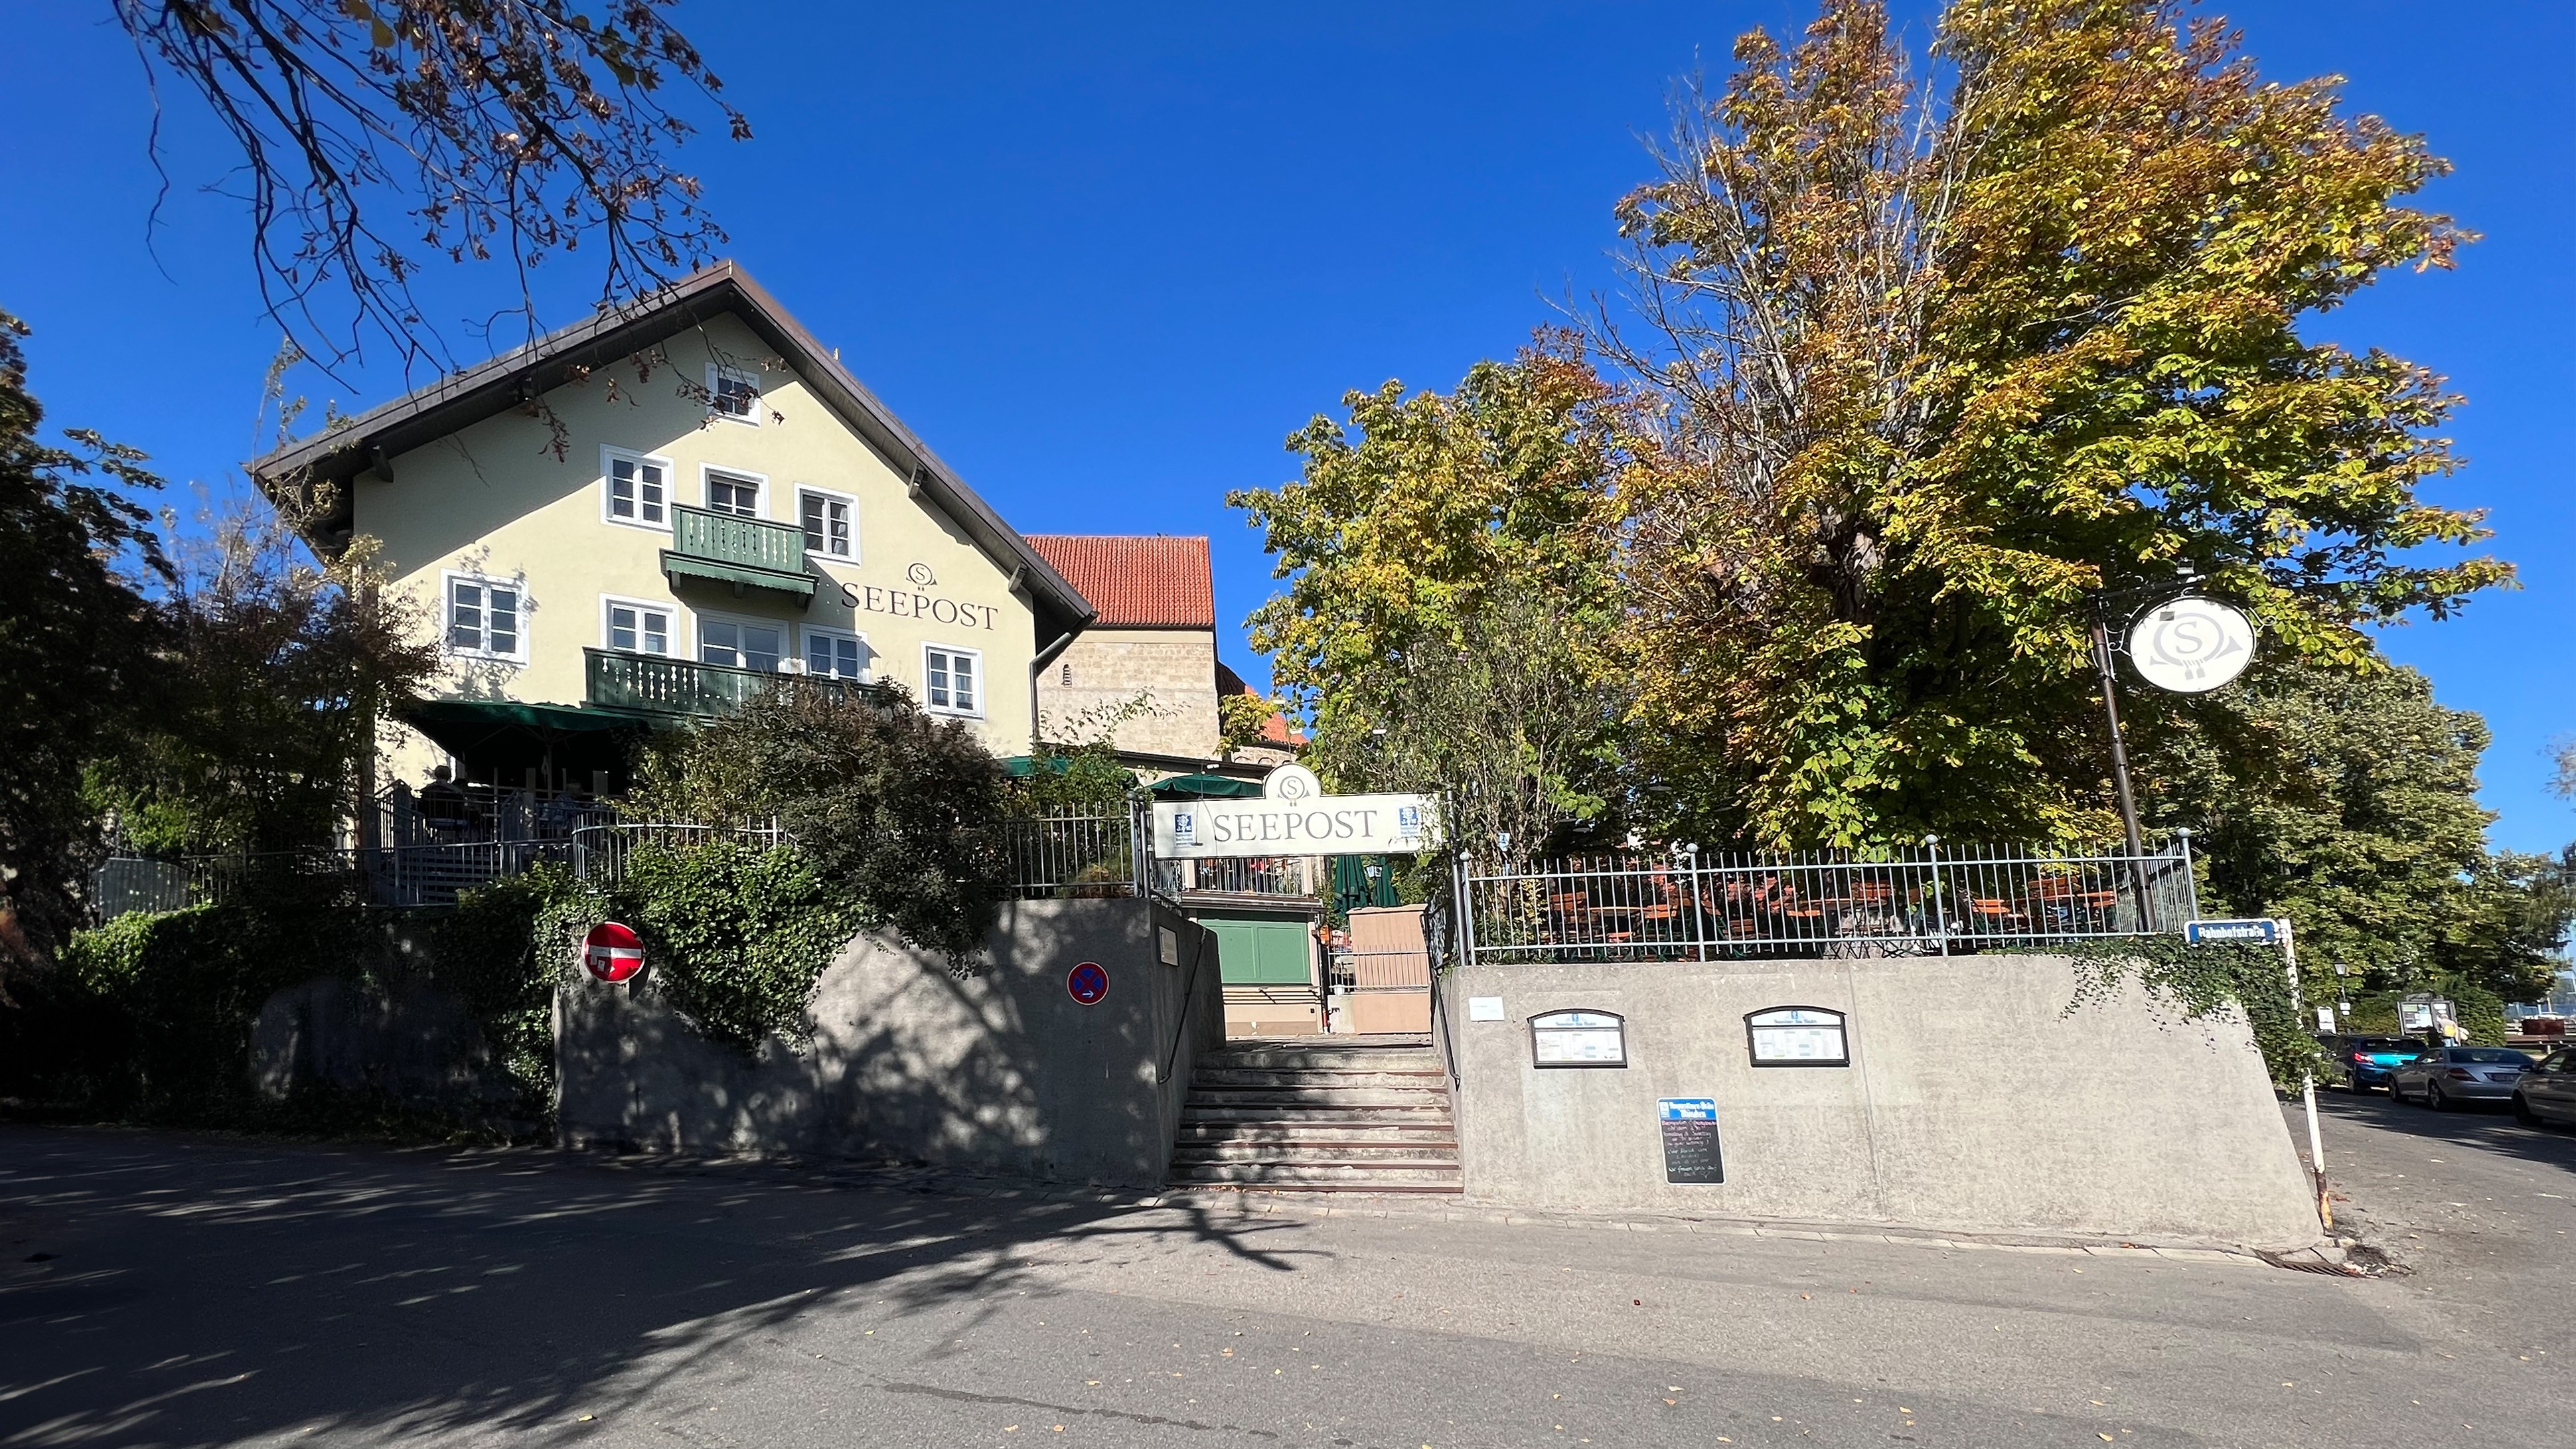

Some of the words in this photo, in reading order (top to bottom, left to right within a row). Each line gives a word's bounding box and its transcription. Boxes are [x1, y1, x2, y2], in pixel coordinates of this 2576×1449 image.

[841, 582, 999, 631] SEEPOST
[2174, 621, 2203, 654] S
[1213, 810, 1378, 842] SEEPOST
